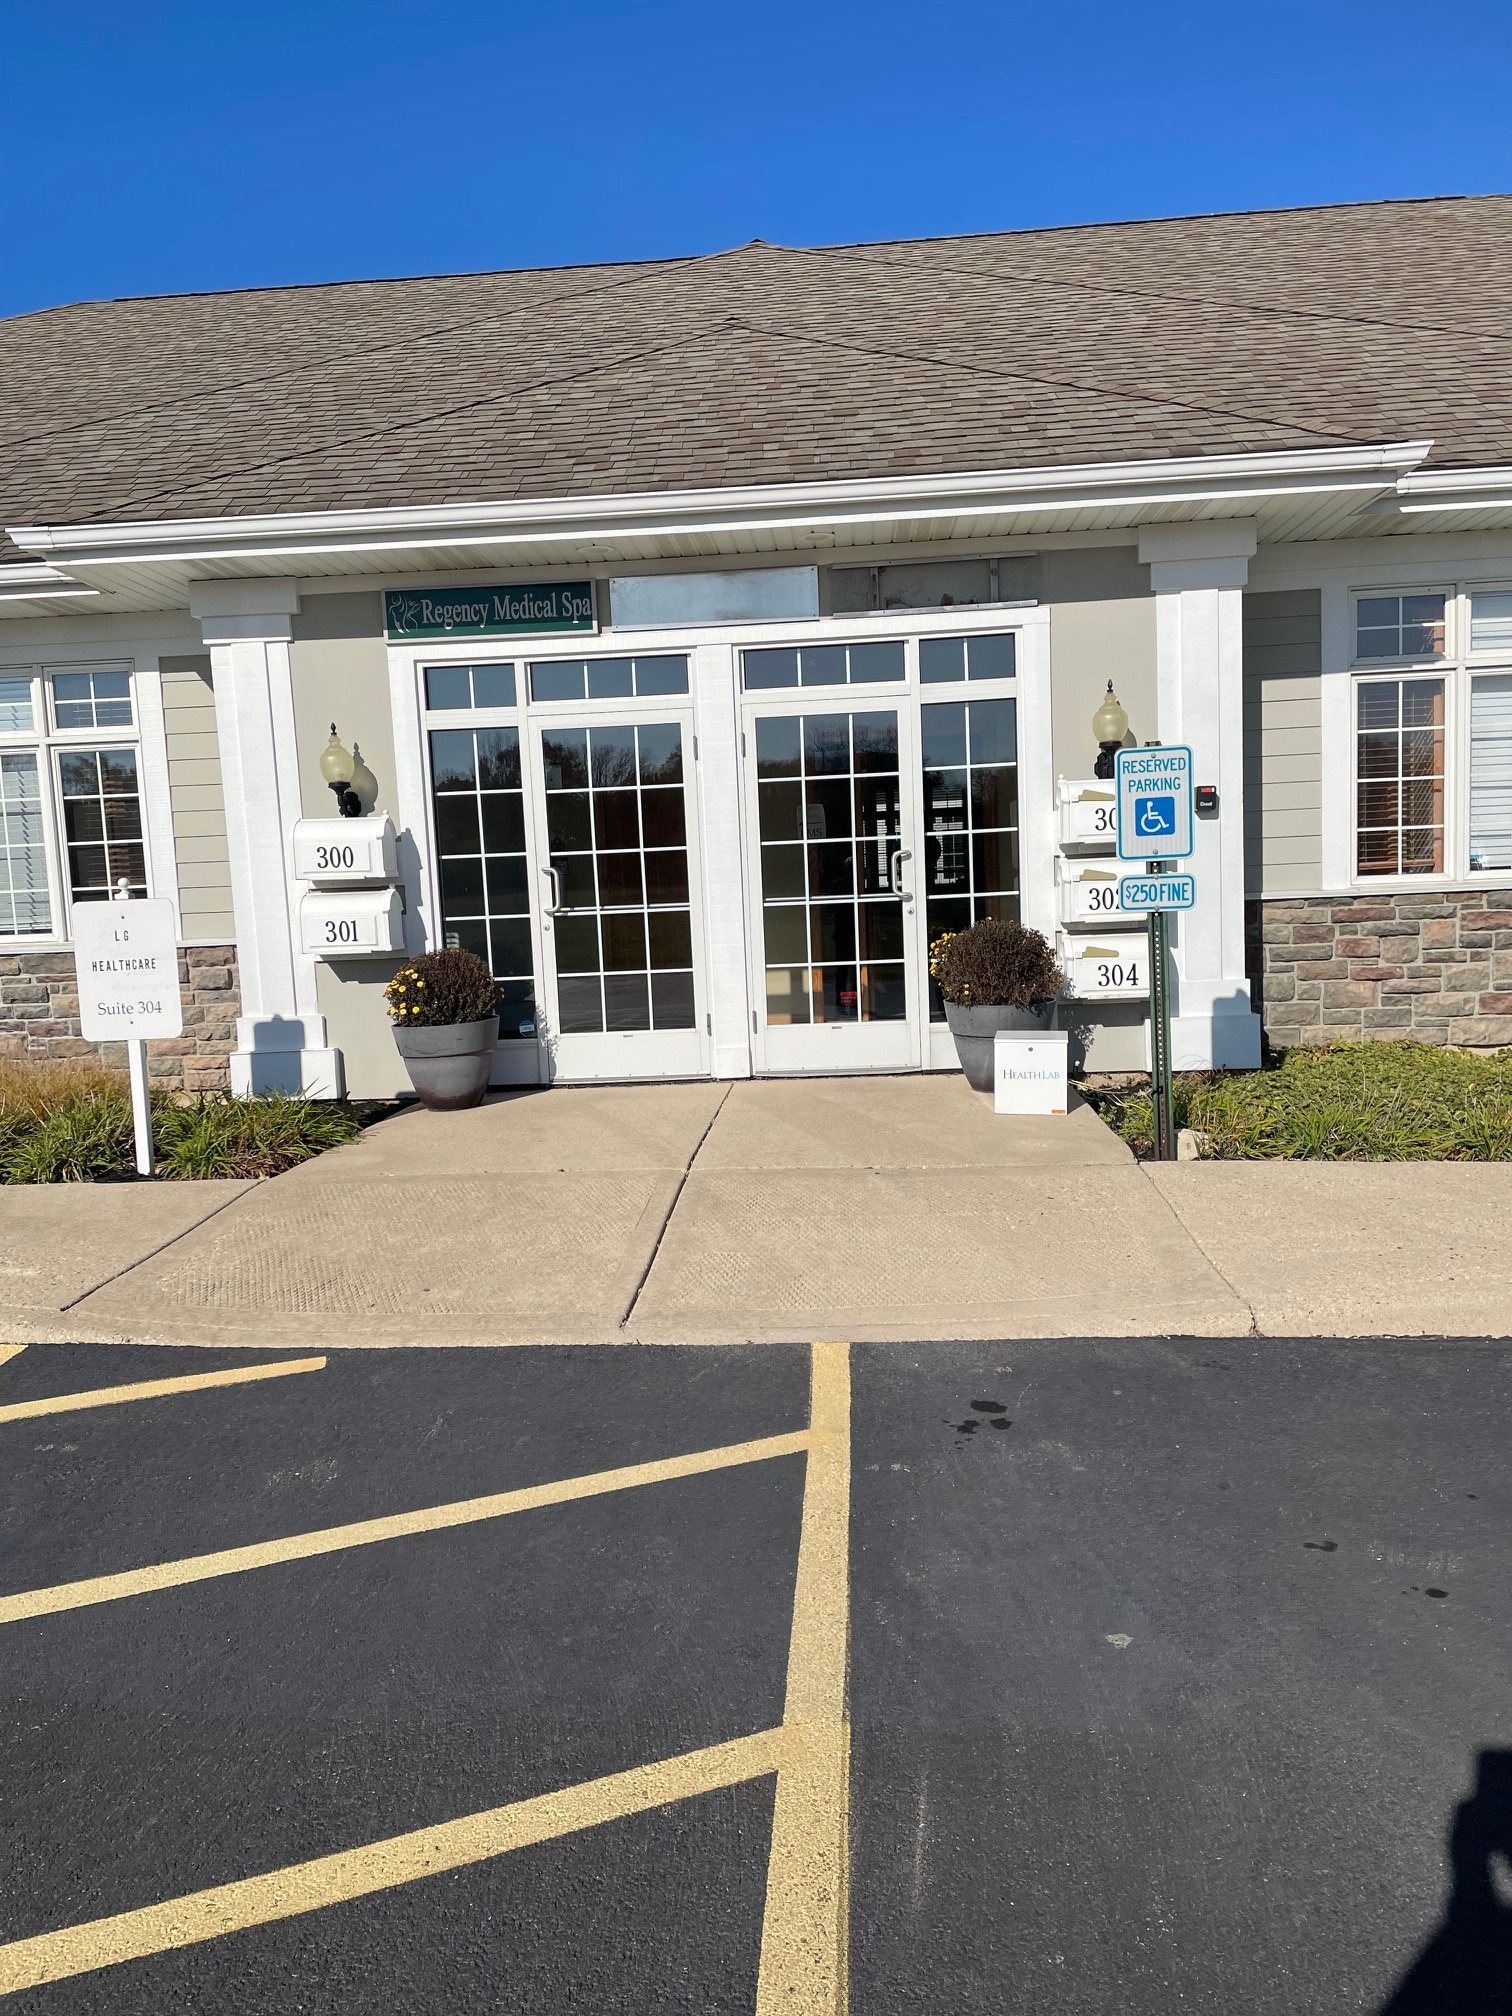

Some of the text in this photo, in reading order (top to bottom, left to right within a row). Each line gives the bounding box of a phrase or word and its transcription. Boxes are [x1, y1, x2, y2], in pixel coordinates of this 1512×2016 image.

[421, 591, 592, 630] Regency Medical Spa
[1122, 757, 1186, 774] RESERVED
[1128, 777, 1181, 793] PARKING
[1095, 807, 1117, 831] 30
[316, 845, 354, 869] 300
[1125, 882, 1190, 903] $250 FINE
[325, 919, 359, 943] 301
[92, 957, 157, 972] HEALTHCARE
[1097, 962, 1139, 987] 304
[97, 1000, 162, 1016] Suite 304
